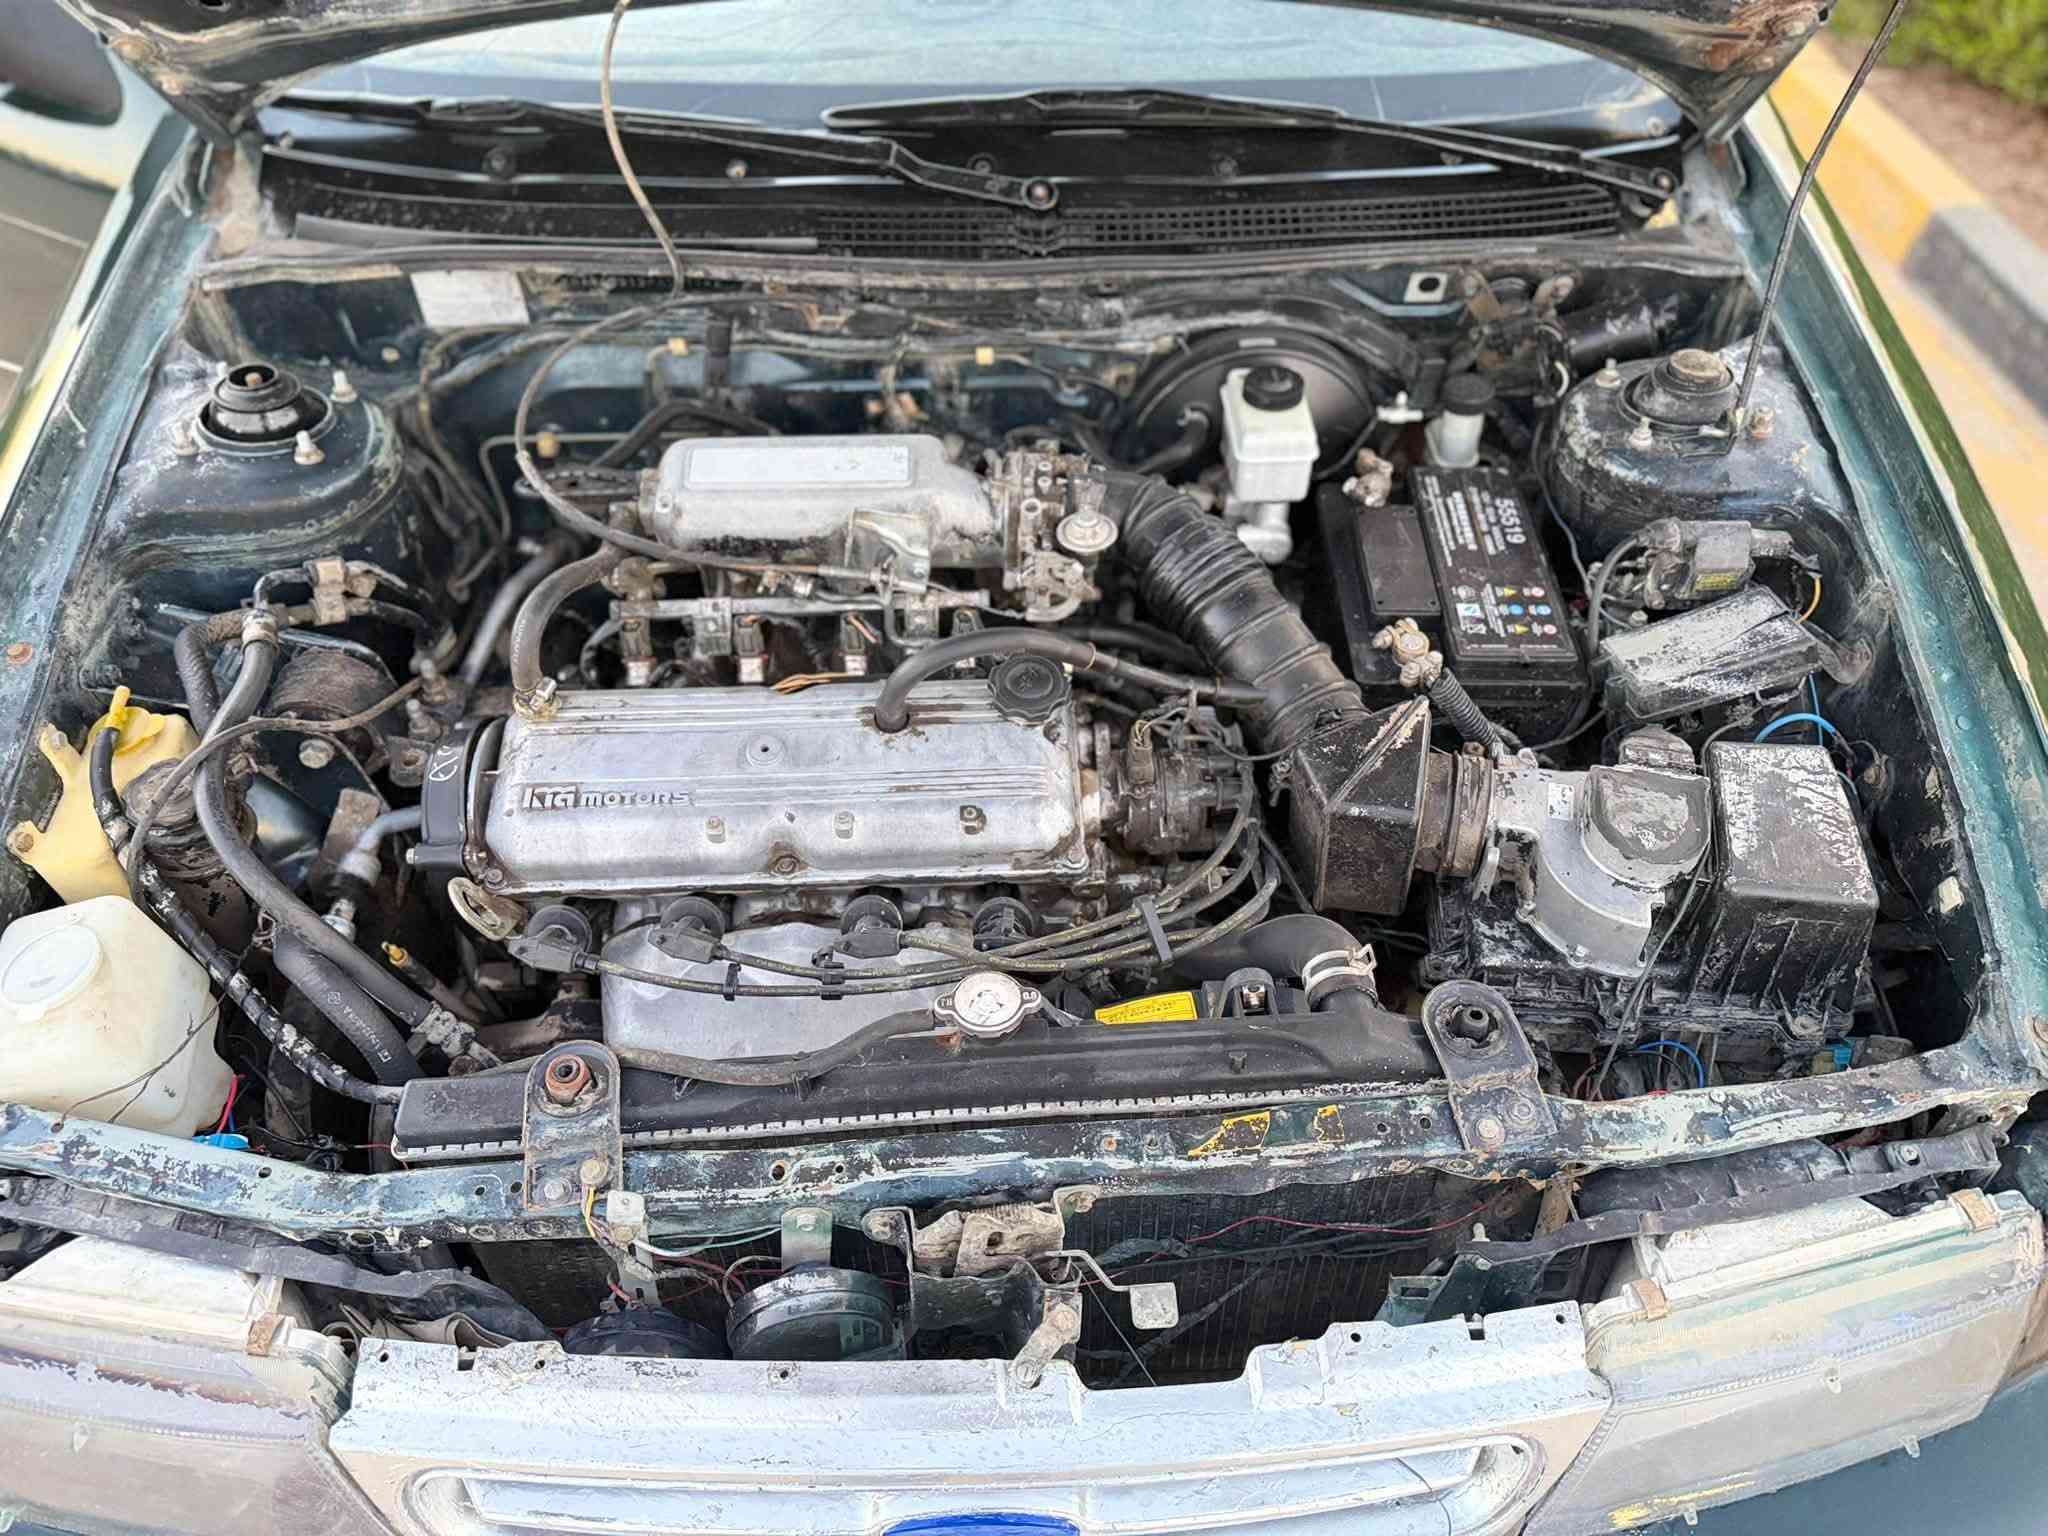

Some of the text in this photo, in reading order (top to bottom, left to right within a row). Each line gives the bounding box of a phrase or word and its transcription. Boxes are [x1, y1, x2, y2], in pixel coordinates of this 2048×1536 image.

[1495, 498, 1527, 545] 55519
[522, 785, 690, 809] KIA MOTORS
